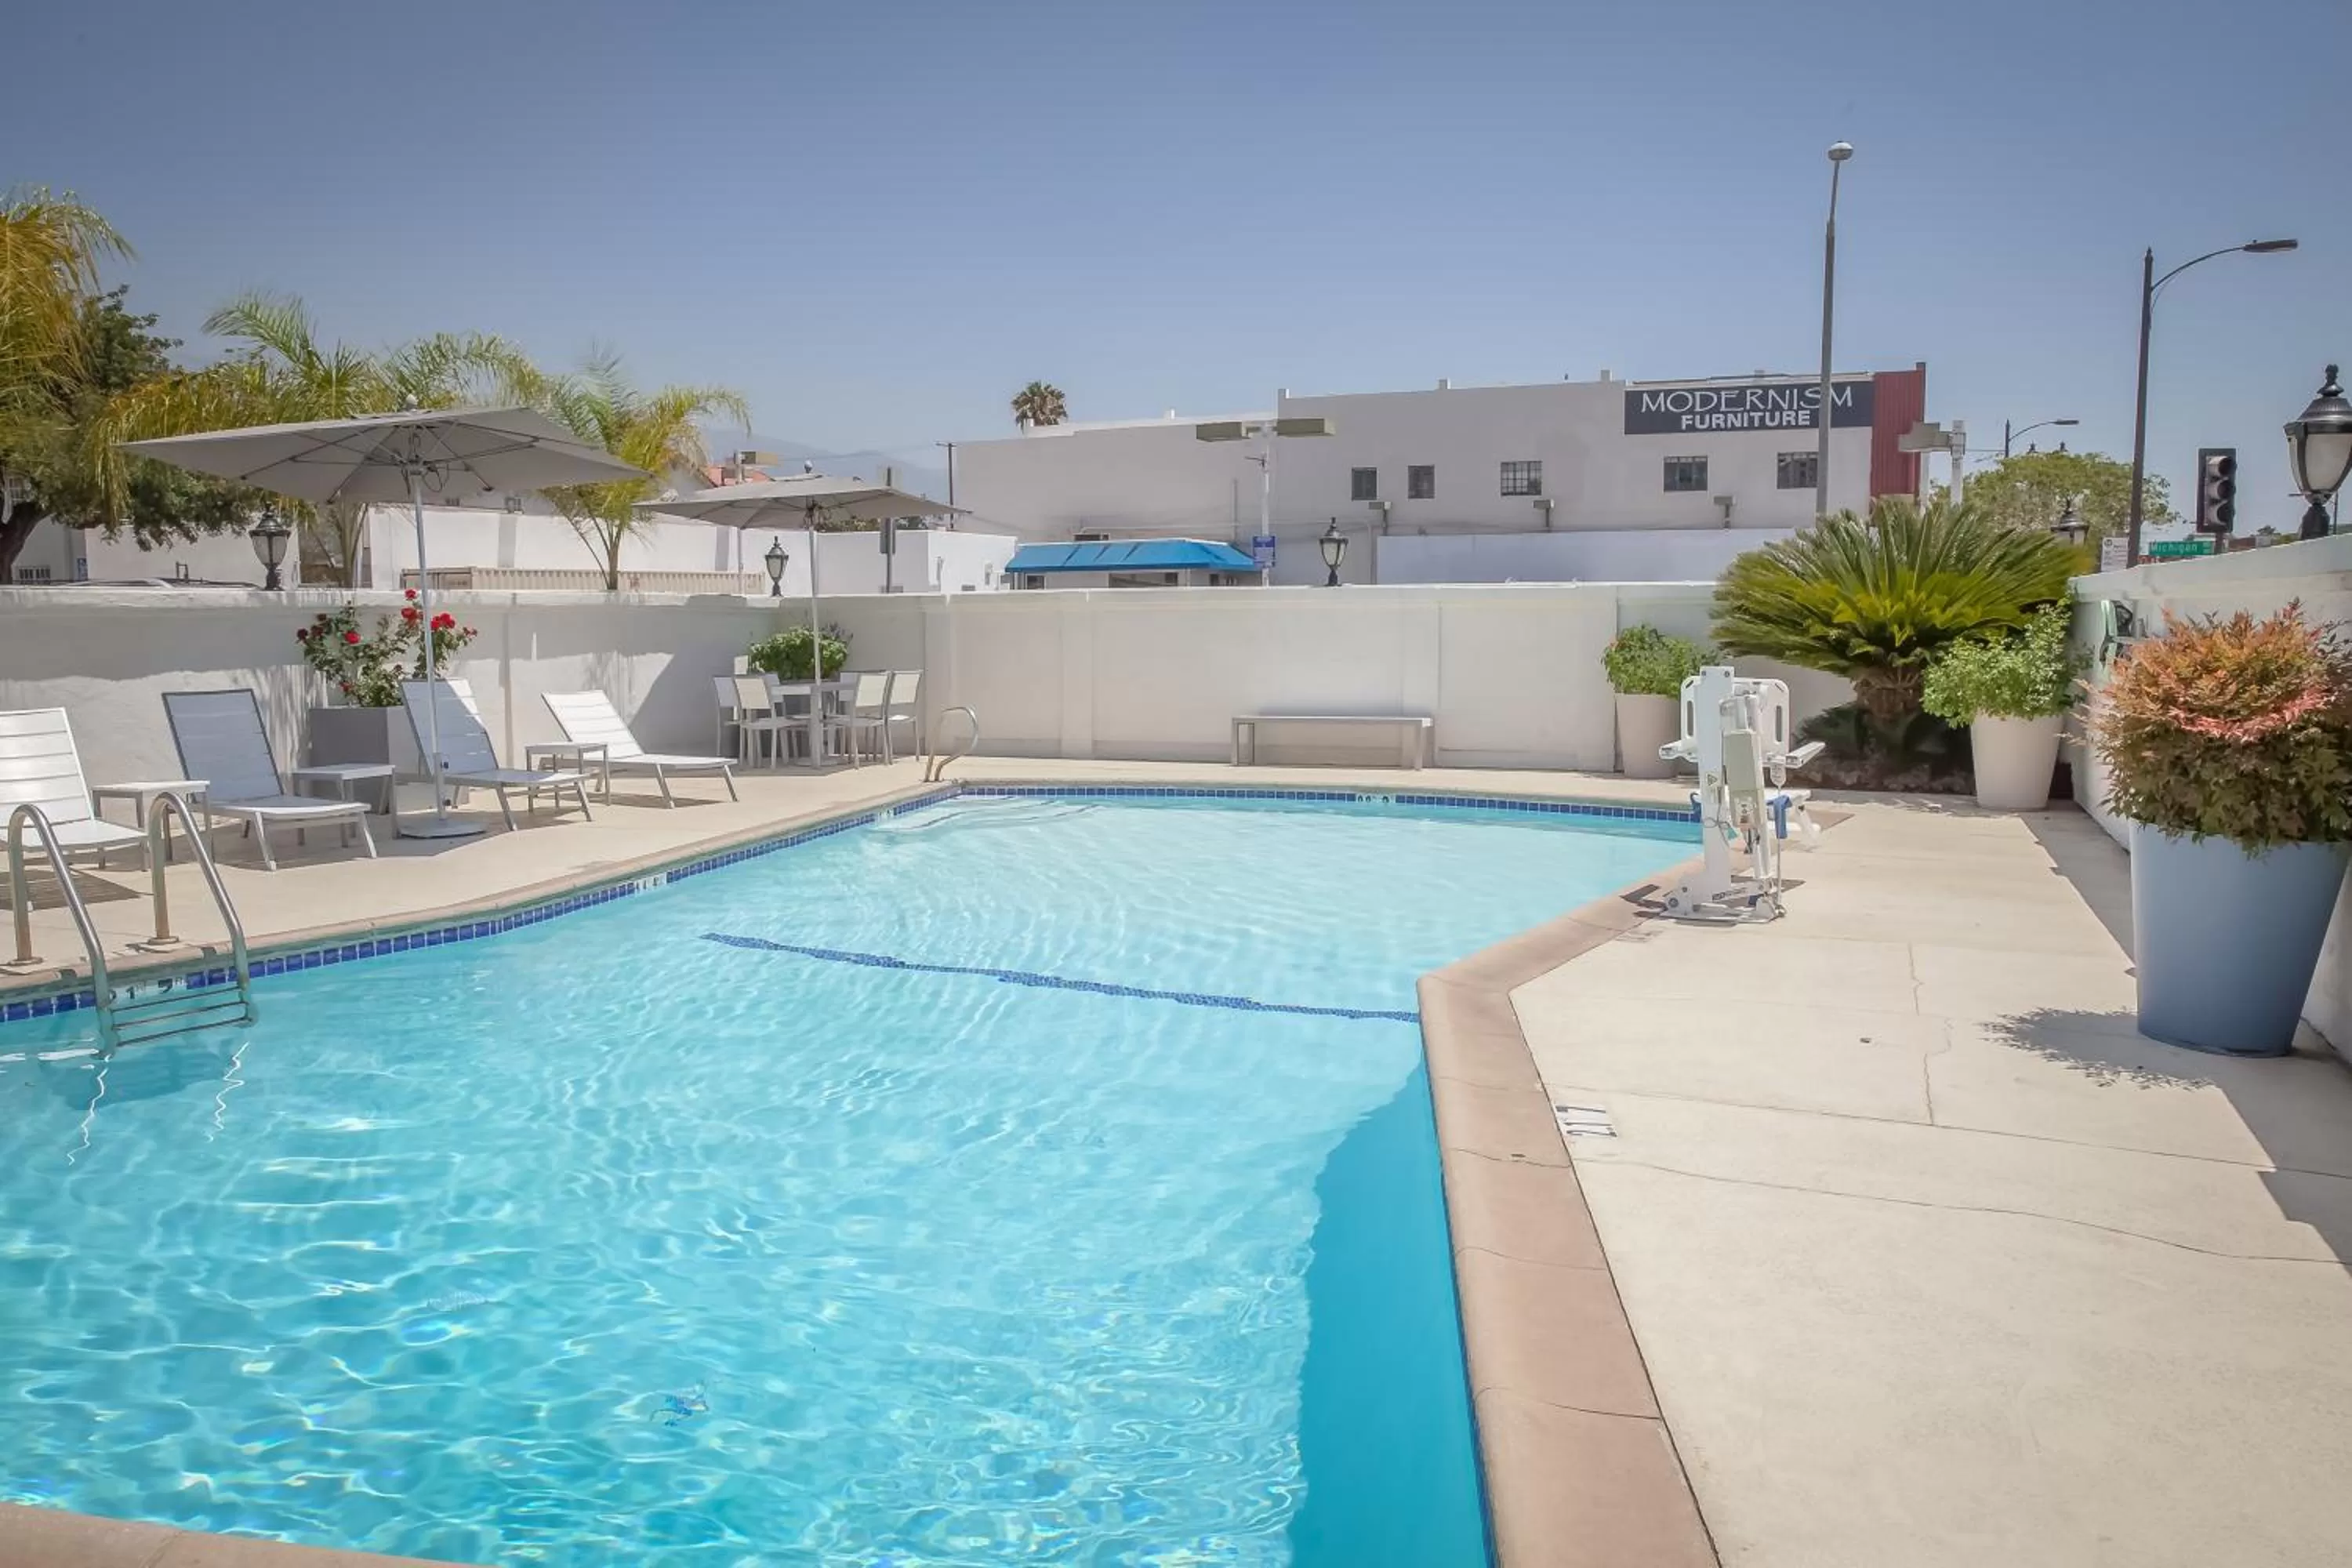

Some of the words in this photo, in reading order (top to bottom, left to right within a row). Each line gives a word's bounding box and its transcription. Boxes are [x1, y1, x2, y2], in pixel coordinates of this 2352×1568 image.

[1641, 386, 1853, 412] MODERNISM
[1681, 409, 1810, 430] FURNITURE
[2151, 542, 2198, 554] Michigan
